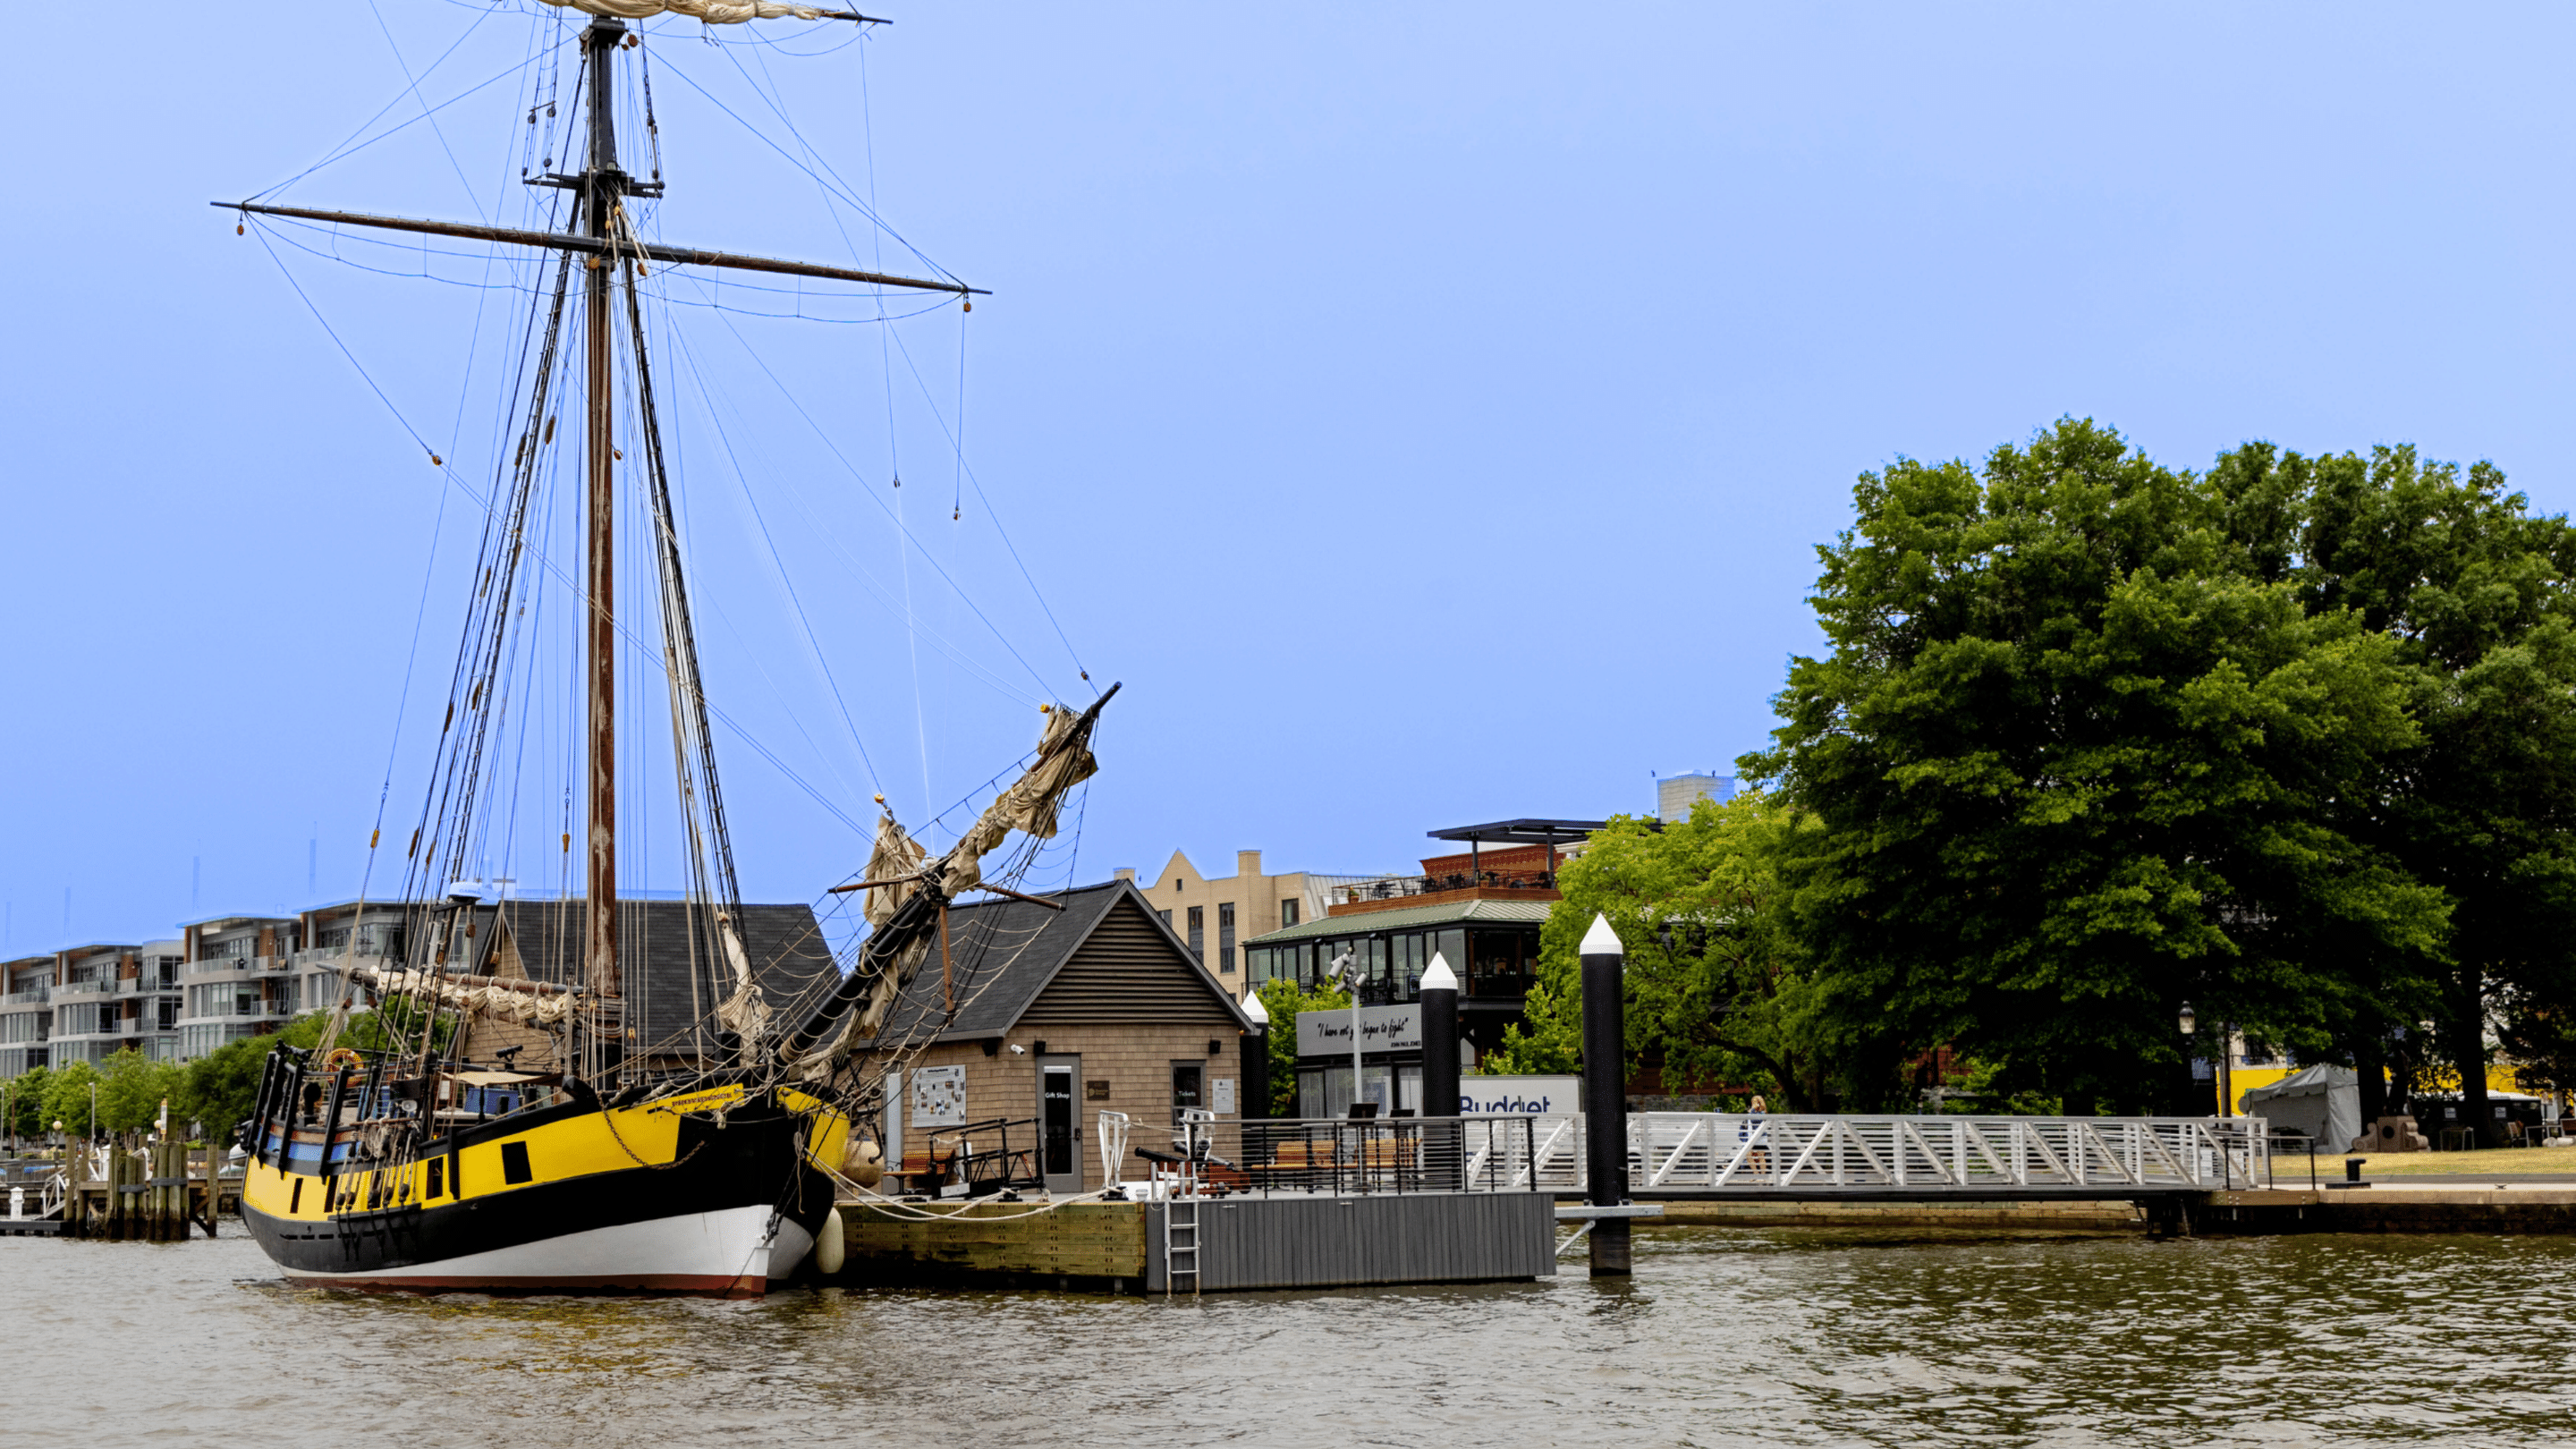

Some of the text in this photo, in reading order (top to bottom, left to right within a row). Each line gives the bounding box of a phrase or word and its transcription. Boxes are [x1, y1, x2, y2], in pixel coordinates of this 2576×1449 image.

[1325, 1023, 1338, 1037] have
[1339, 1024, 1349, 1037] not
[1380, 1021, 1388, 1034] to
[672, 1093, 732, 1106] PROVIDENCE
